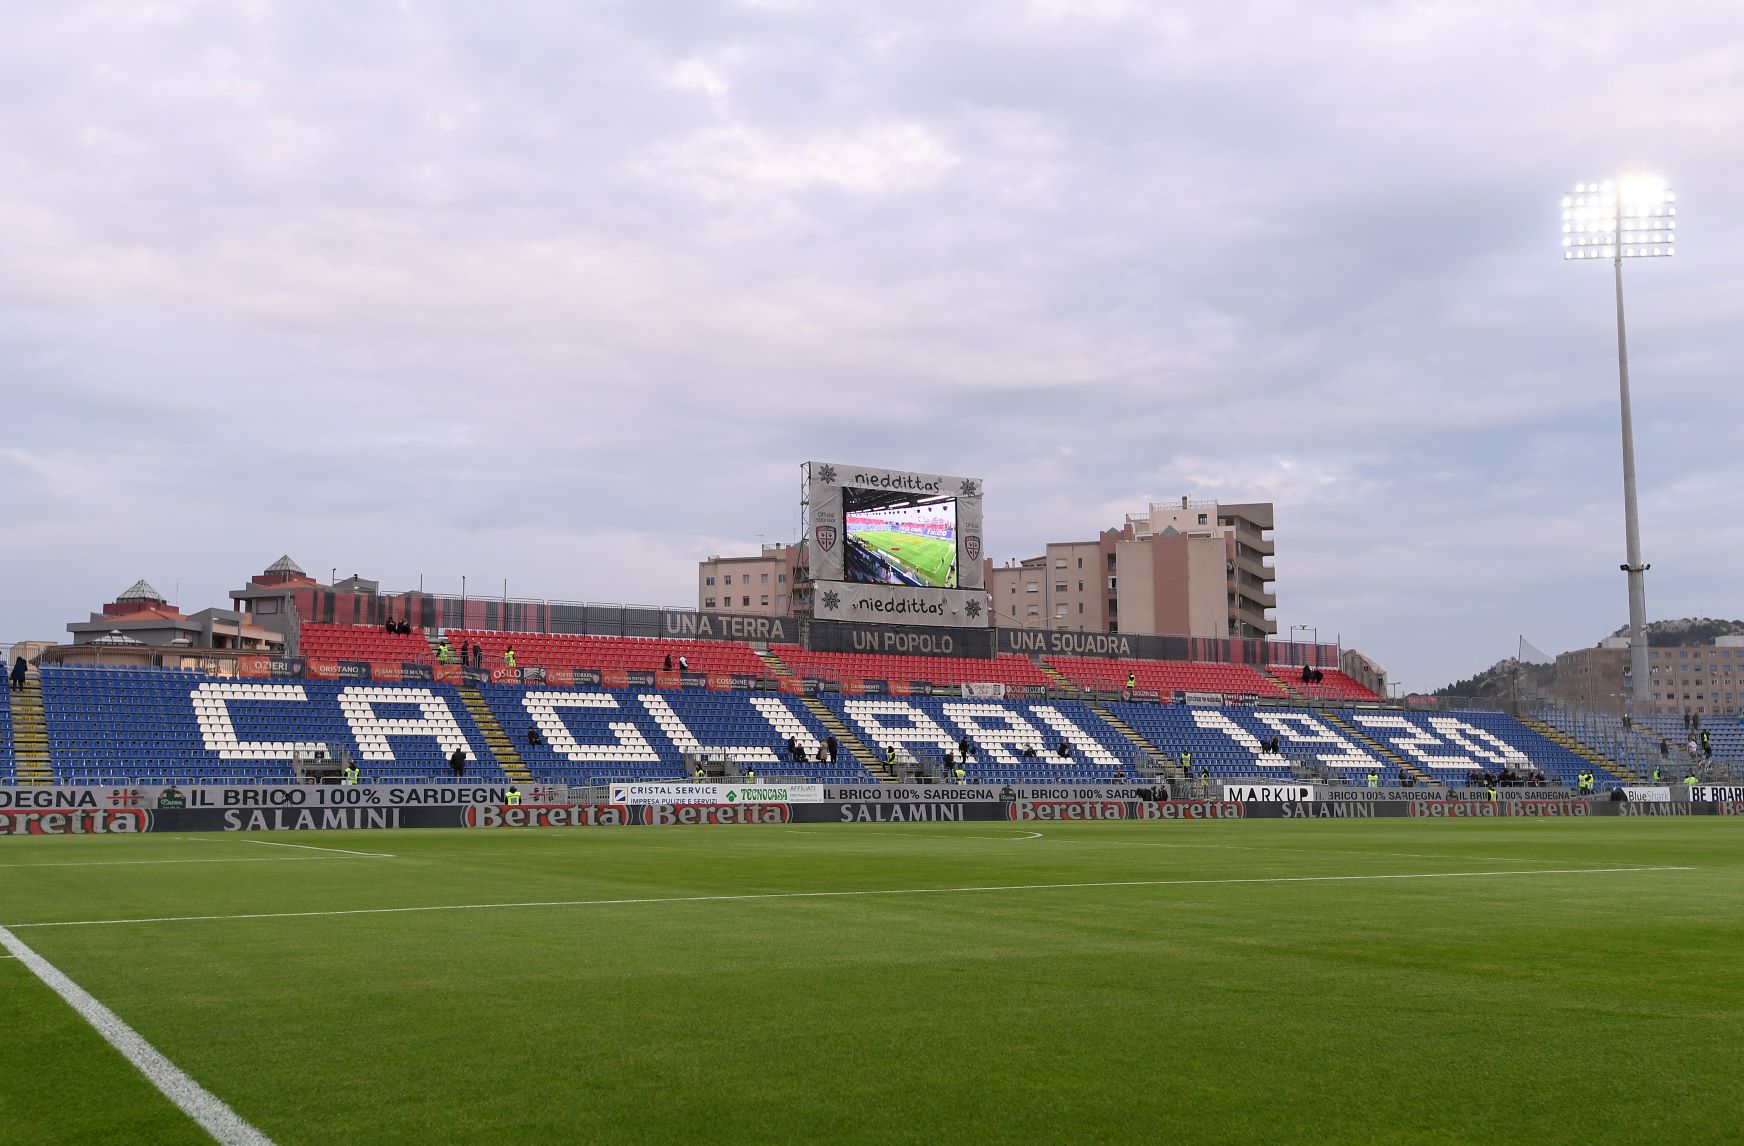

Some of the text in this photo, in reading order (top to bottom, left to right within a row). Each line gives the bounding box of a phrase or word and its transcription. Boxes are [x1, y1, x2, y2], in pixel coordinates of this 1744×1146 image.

[854, 474, 940, 494] nieddittas
[858, 596, 944, 616] nieddittas
[666, 613, 785, 639] UNA TERRA
[853, 631, 953, 653] UN POPOLO
[1010, 632, 1131, 655] UNA SQUADRA
[254, 661, 288, 671] OZIERI
[493, 669, 521, 678] OSILO
[192, 790, 214, 806] IL
[223, 789, 306, 806] BRICO
[316, 789, 381, 805] 100%
[388, 788, 505, 804] SARDEGN
[630, 786, 718, 795] CRISTAL SERVICE
[740, 788, 788, 801] TECNOCASA
[840, 789, 882, 799] BRICO
[885, 789, 920, 799] 100%
[923, 789, 994, 799] SARDEGNA
[1017, 789, 1028, 799] IL
[1031, 789, 1070, 799] BRICO
[1072, 789, 1103, 799] 100%
[1106, 789, 1143, 799] SARD
[1229, 787, 1309, 801] MARKUP
[1361, 791, 1385, 800] 100%
[1388, 791, 1441, 800] SARDEGNA
[1459, 791, 1467, 800] IL
[1500, 791, 1523, 800] 100%
[1524, 791, 1570, 800] SARDEGNA
[1691, 787, 1706, 801] BE
[472, 805, 624, 827] Beretta
[650, 803, 786, 825] Beretta
[840, 803, 964, 822] SALAMINI
[1014, 801, 1121, 820] Beretta
[1143, 800, 1238, 819] Beretta
[1282, 802, 1375, 818] SALAMINI
[1415, 800, 1494, 817] Beretta
[1512, 800, 1586, 816] Beretta
[1619, 801, 1692, 816] SALAMINI
[223, 808, 401, 831] SALAMINI
